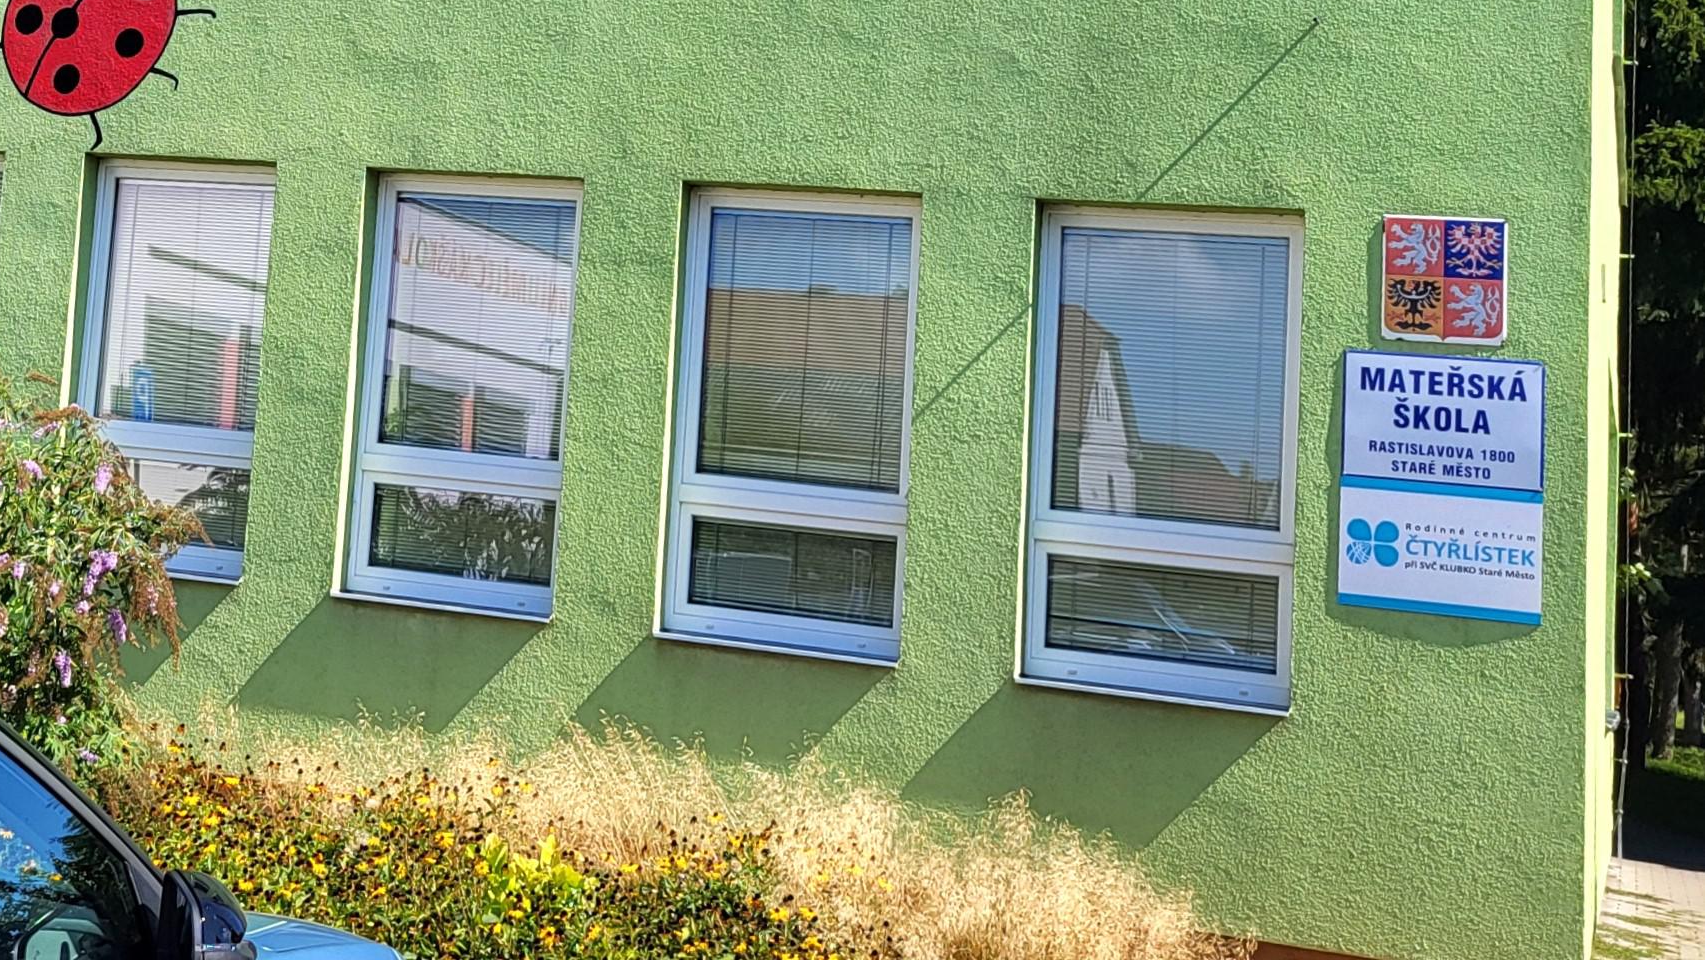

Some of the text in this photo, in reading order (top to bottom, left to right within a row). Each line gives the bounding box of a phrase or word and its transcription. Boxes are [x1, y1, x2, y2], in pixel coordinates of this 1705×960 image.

[1360, 365, 1527, 402] MATEŘSKÁ
[1393, 396, 1491, 435] ŠKOLA
[1369, 439, 1515, 463] RASTISLAVOVA 1800
[1391, 459, 1491, 479] STARÉ MĚSTO
[1405, 522, 1535, 542] Rodinné centrum
[1405, 534, 1535, 567] ČTYŘLÍSTEK
[1419, 560, 1437, 570] SVČ
[1439, 564, 1476, 575] KLUBKO
[1478, 567, 1502, 577] Staré
[1505, 570, 1535, 580] Město
